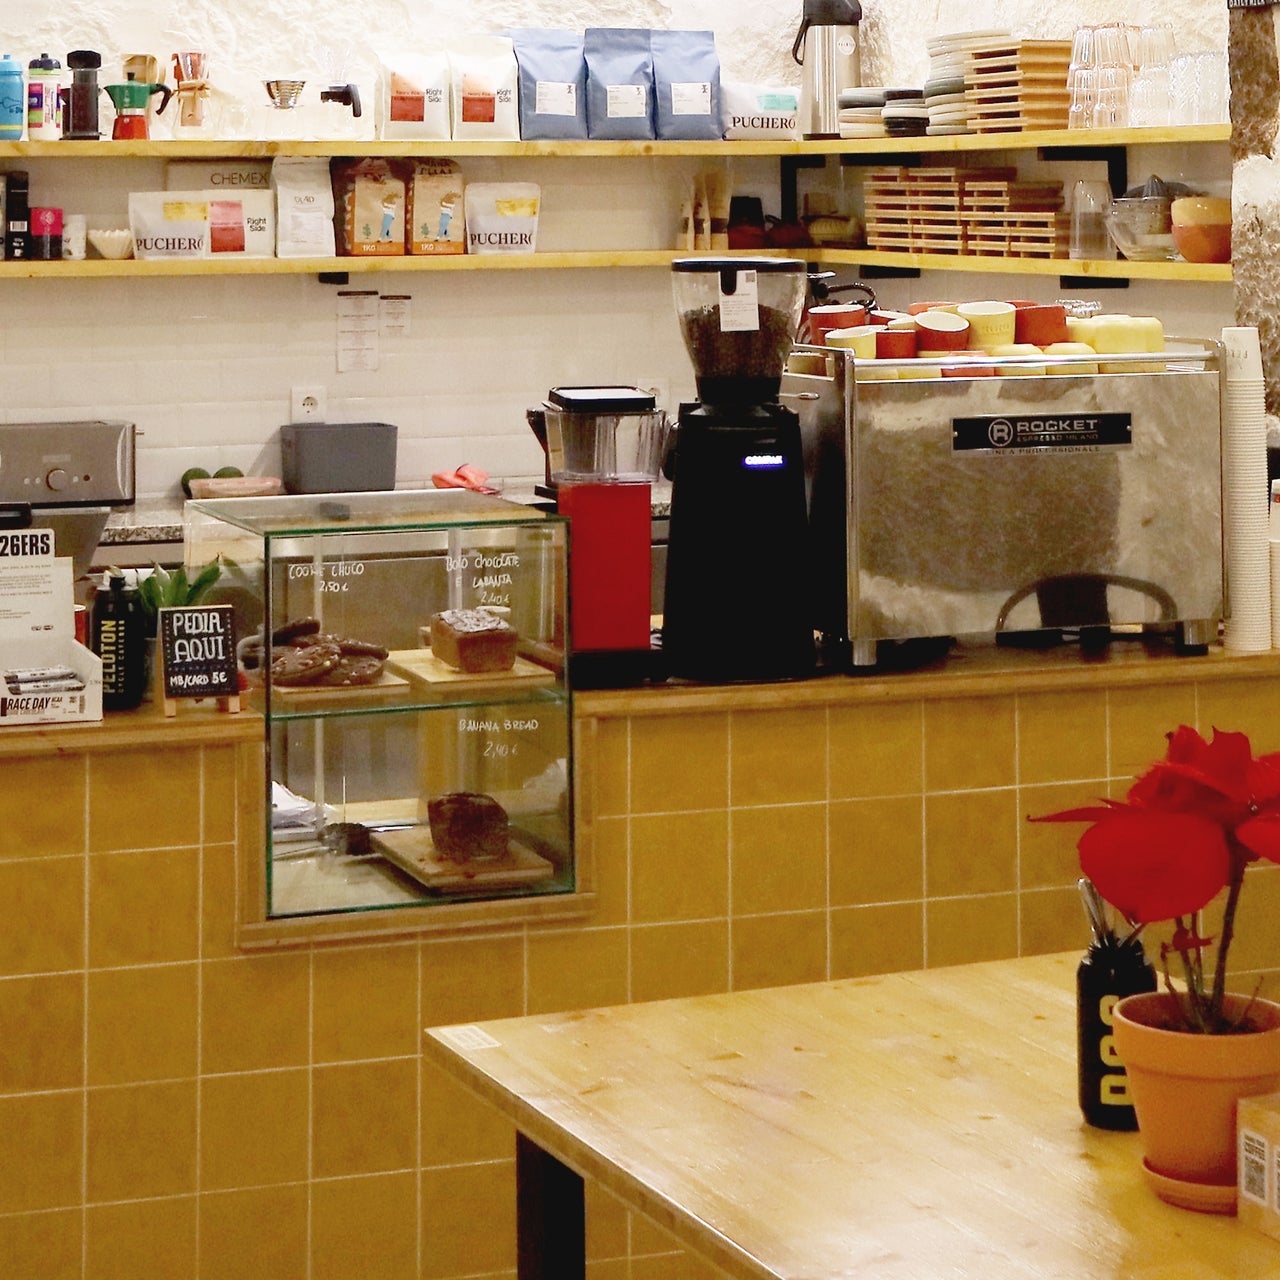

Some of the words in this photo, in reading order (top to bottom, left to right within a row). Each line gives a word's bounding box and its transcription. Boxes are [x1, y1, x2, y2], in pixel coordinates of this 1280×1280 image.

[426, 89, 443, 97] Right
[497, 89, 512, 97] Right
[732, 116, 796, 130] PUCHERO
[210, 172, 269, 185] CHEMEX
[247, 217, 267, 226] Right
[1016, 419, 1098, 432] ROCKET
[1017, 434, 1062, 442] ESPRESSO
[173, 636, 226, 663] AQUI
[101, 620, 117, 694] PELOTON
[170, 674, 209, 689] MB/CARD
[212, 672, 228, 685] 5€
[6, 698, 31, 710] RACE
[32, 697, 52, 710] DAY
[459, 719, 500, 732] BANANA
[503, 719, 539, 731] BREAD
